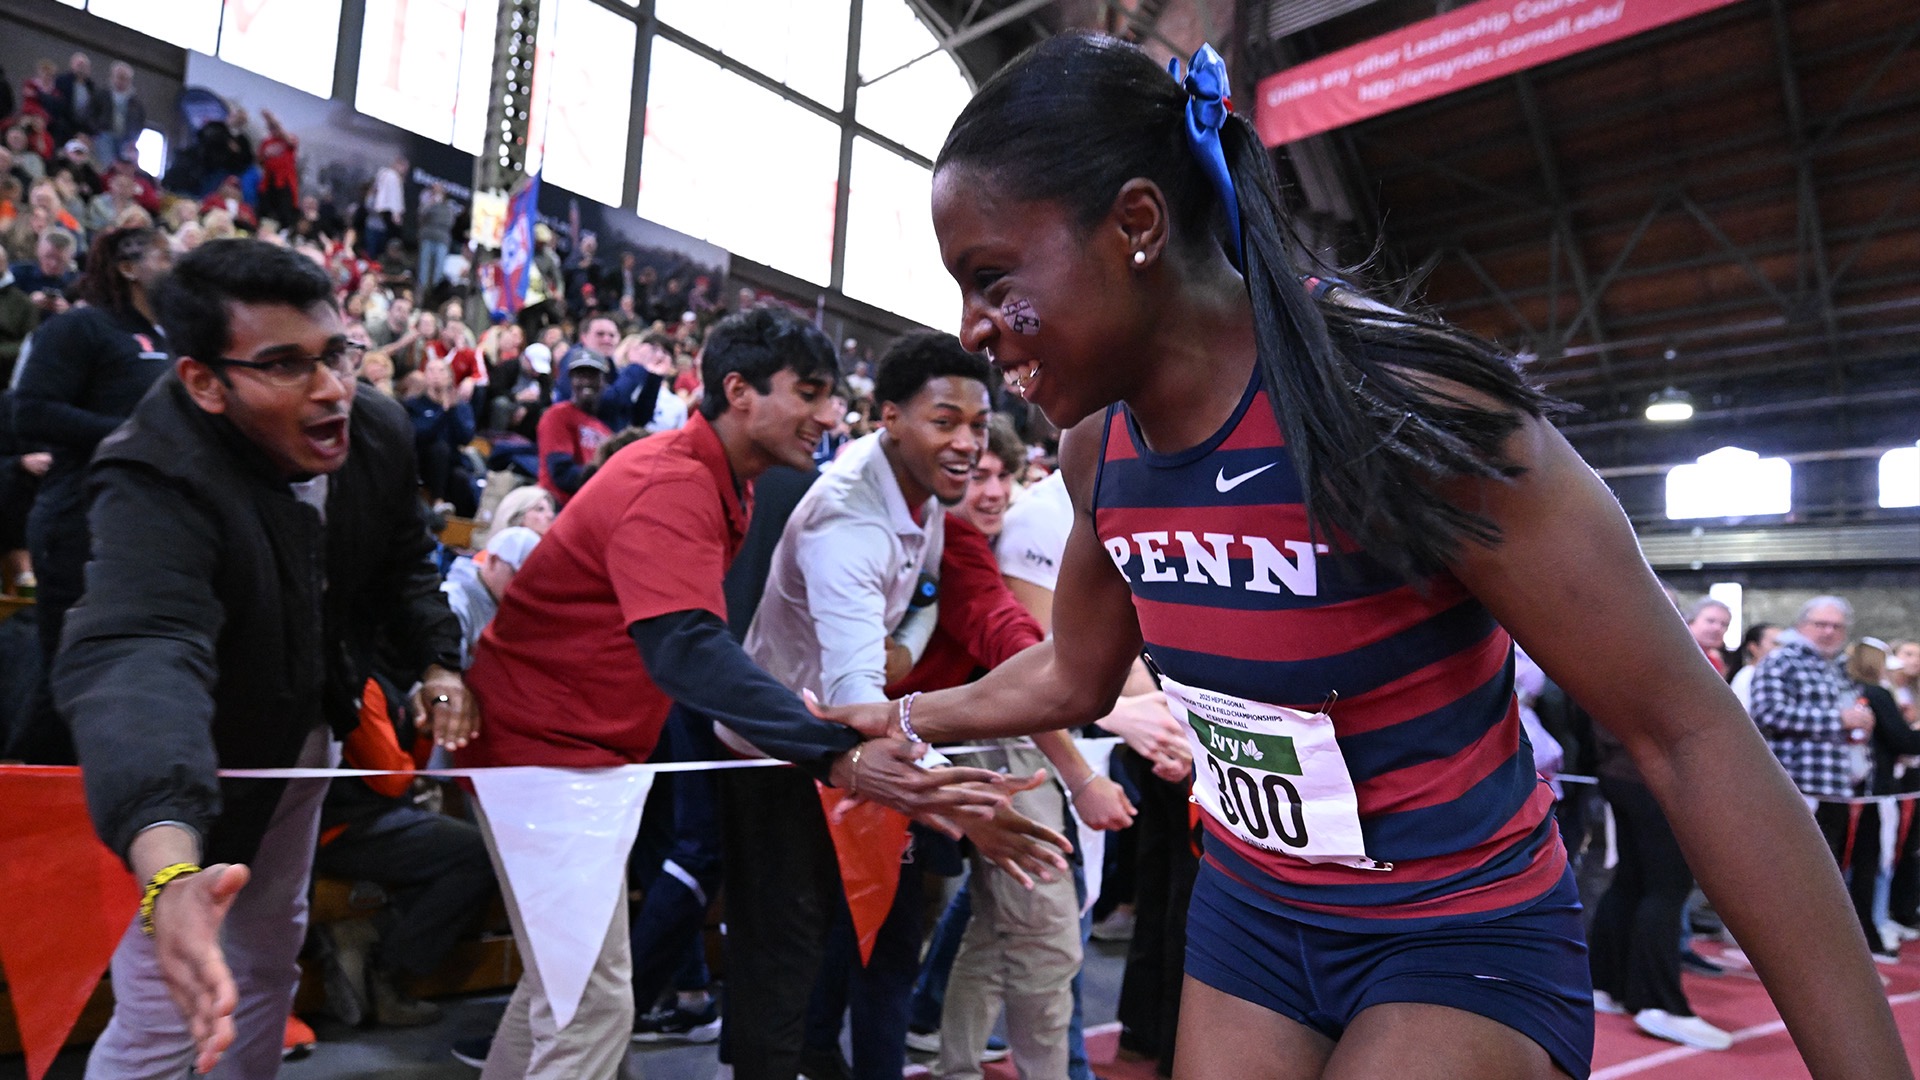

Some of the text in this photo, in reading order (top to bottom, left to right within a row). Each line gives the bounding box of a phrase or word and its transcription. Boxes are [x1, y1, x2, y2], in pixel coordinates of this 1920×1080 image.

[1320, 69, 1350, 89] any
[1354, 49, 1400, 77] other
[1403, 12, 1510, 60] Leadership
[1104, 531, 1329, 596] PENN
[1197, 702, 1213, 711] TRACK
[1216, 707, 1231, 716] FIELD
[1231, 709, 1283, 722] CHAMPIONSHIPS
[1211, 695, 1246, 709] HEPTAGONAL
[1233, 720, 1248, 729] HALL
[1209, 725, 1239, 761] Ivy
[1207, 754, 1308, 848] 300
